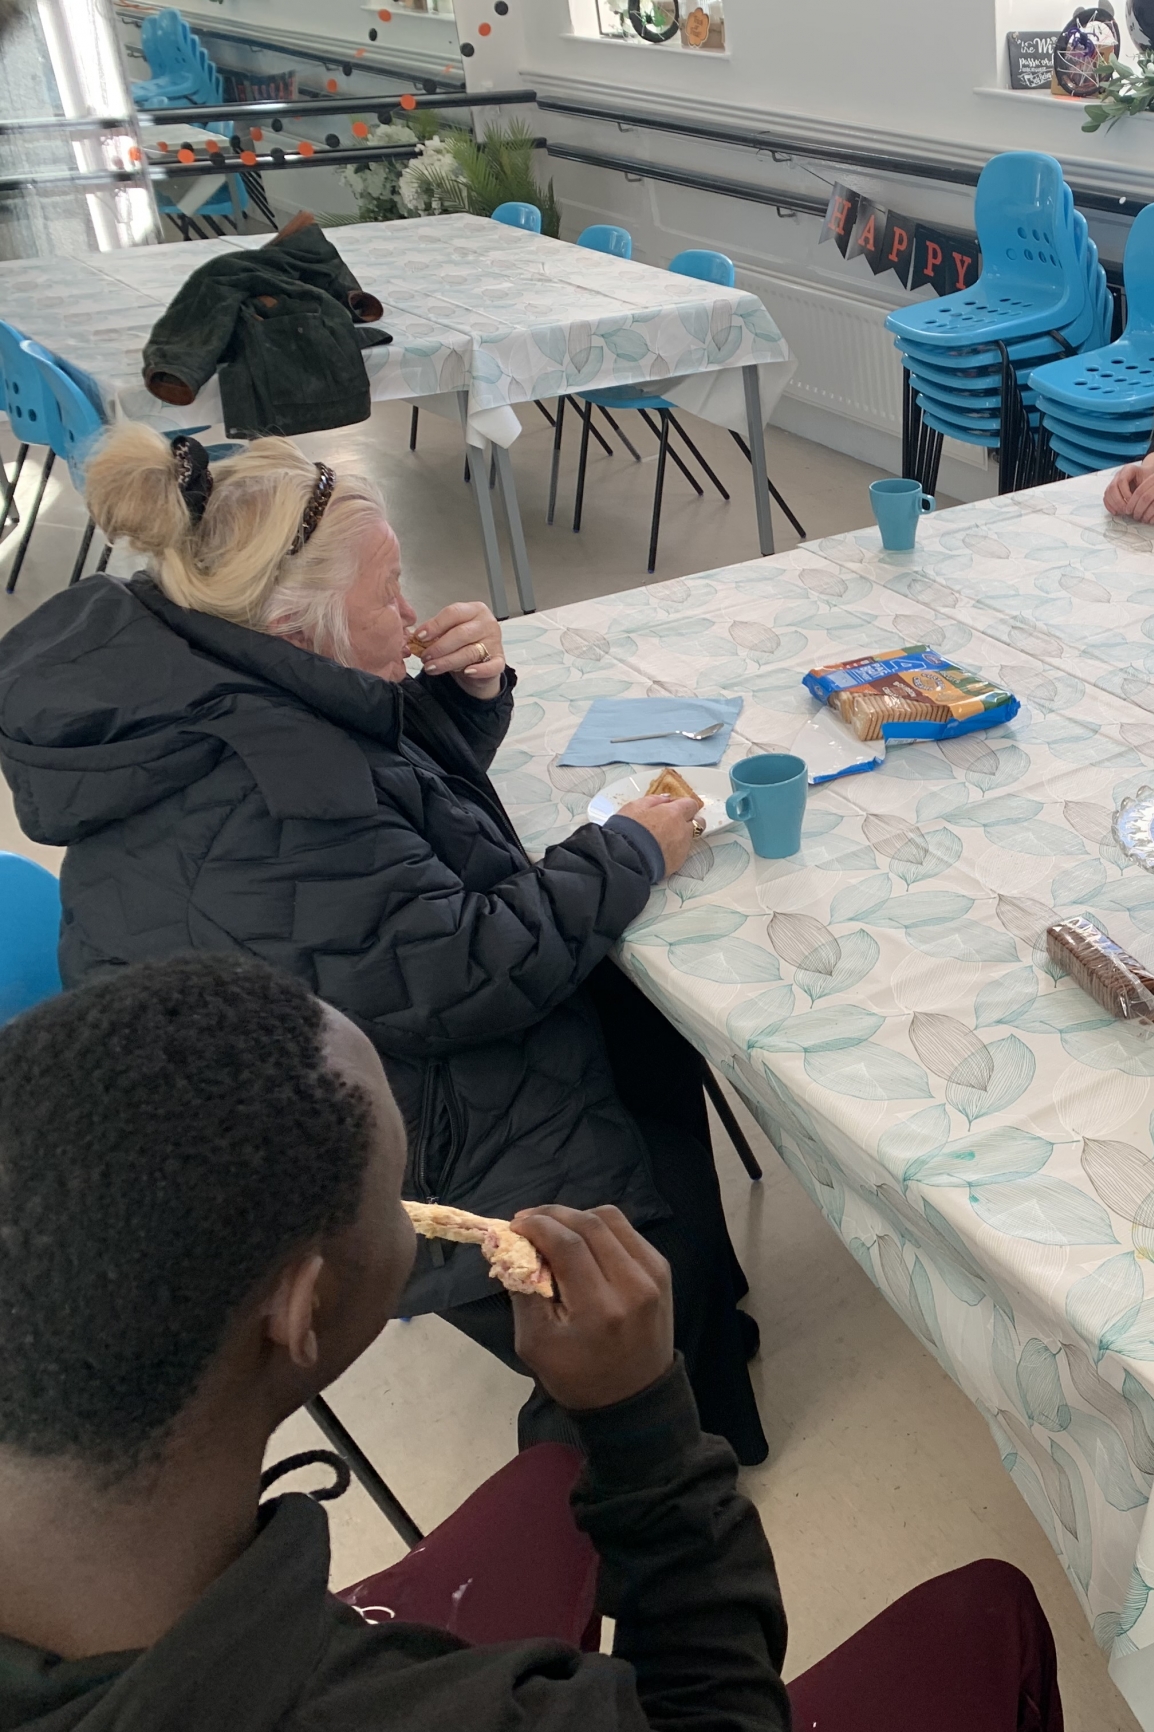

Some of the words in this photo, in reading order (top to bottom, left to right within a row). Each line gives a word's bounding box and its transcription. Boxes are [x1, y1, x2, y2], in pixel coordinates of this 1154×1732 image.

[1021, 41, 1035, 53] the
[1019, 54, 1054, 72] password
[828, 196, 971, 290] HAPPY
